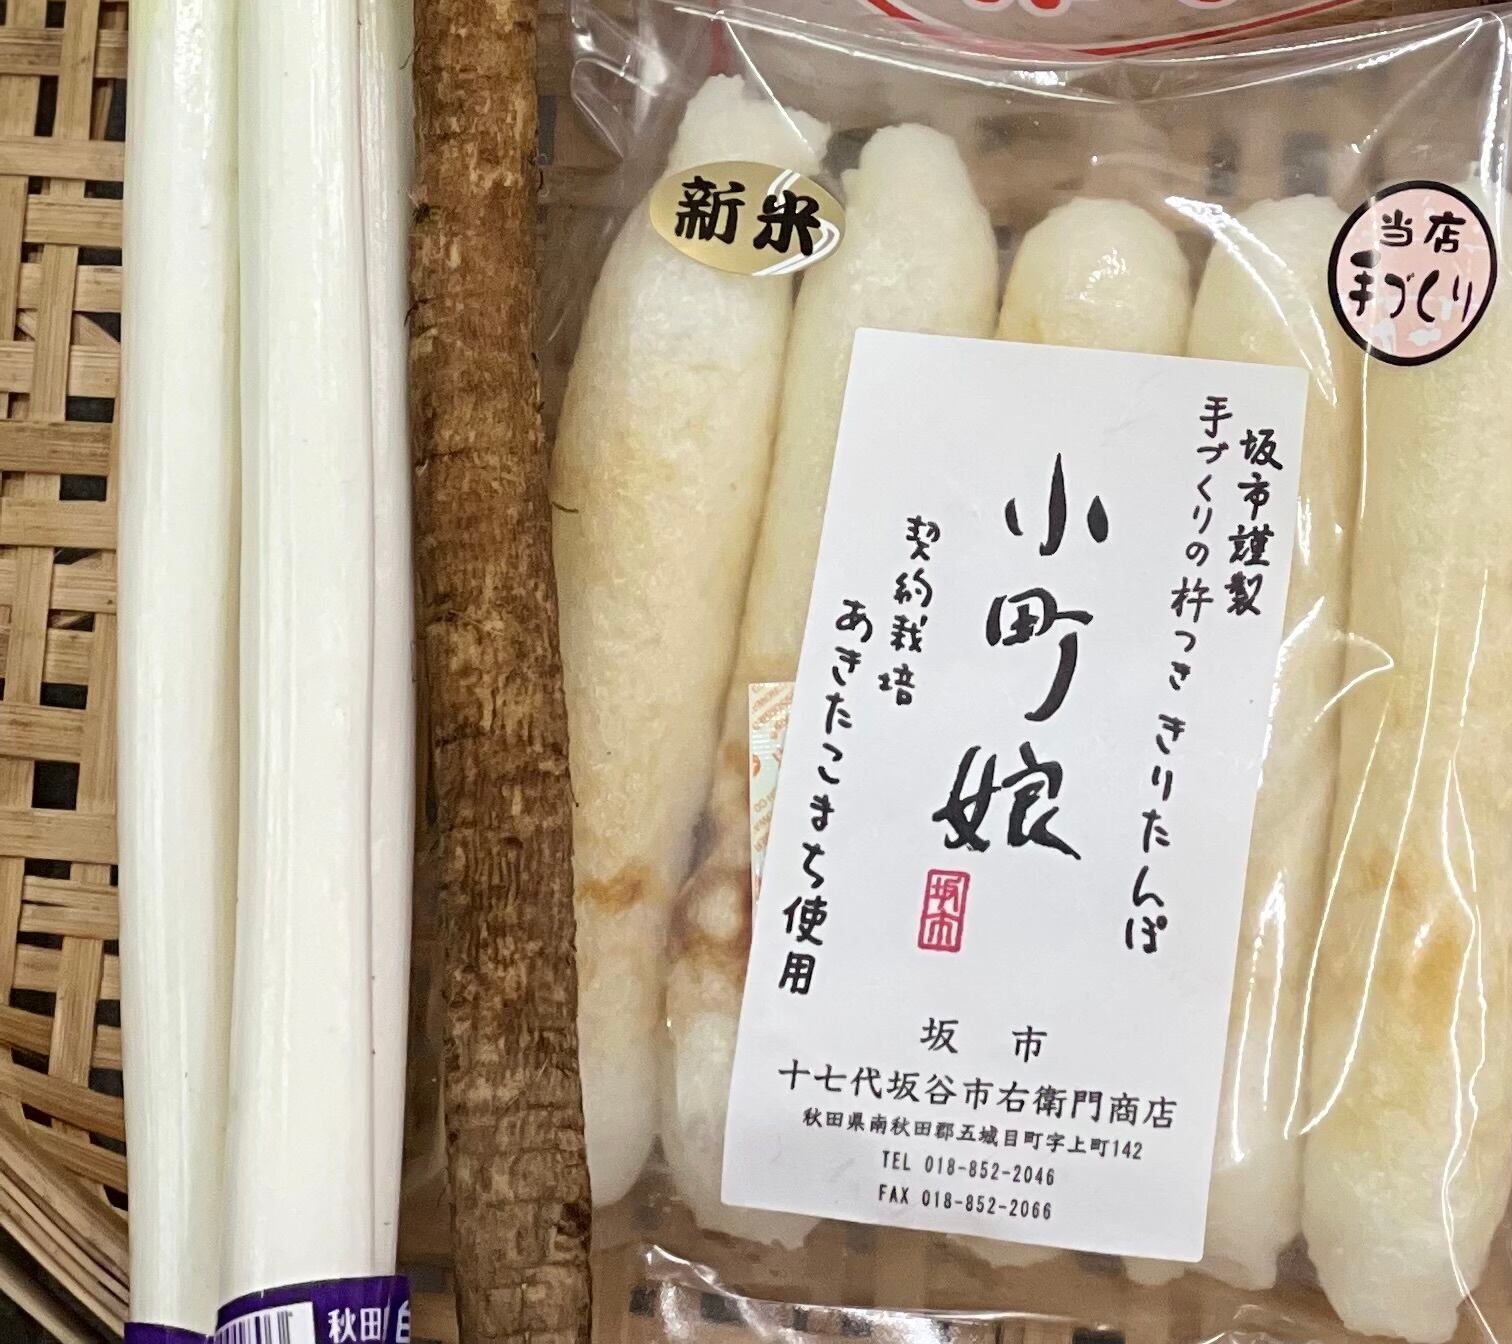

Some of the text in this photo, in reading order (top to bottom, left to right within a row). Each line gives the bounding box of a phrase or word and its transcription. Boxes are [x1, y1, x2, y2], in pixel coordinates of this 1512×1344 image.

[674, 177, 821, 256] 新米
[1380, 211, 1466, 253] 当店
[1348, 250, 1474, 322] 手づくり
[1225, 428, 1284, 616] 坂市謹製
[878, 515, 941, 707] 契約栽培
[931, 452, 1109, 860] 小町娘
[778, 599, 874, 995] あきたこまち使用
[778, 1059, 1178, 1130] 十七代坂谷市右衛門商店
[878, 1184, 1053, 1221] FAX 018-852-2066
[881, 1150, 1056, 1187] TEL 018-852-2046
